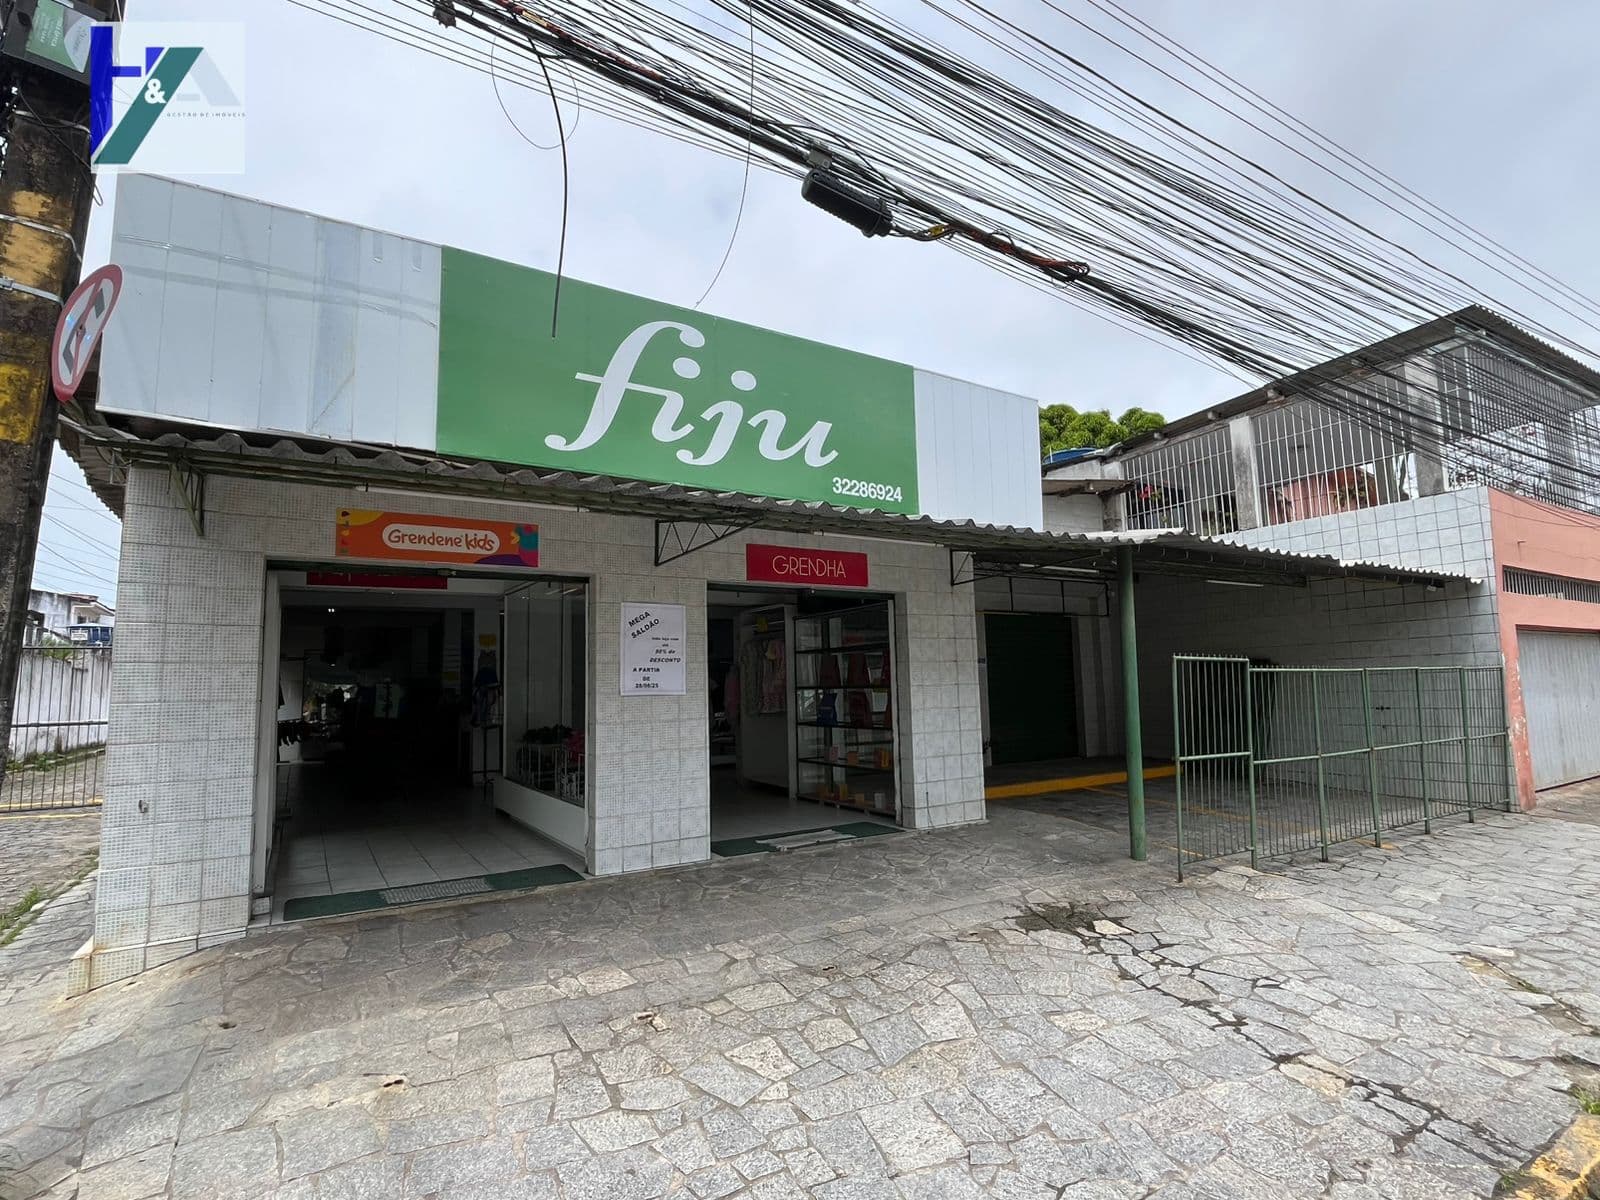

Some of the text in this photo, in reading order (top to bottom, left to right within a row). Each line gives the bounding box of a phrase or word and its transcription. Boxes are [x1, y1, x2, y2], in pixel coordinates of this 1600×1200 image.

[544, 321, 839, 467] fiju
[832, 476, 903, 503] 32286924
[388, 529, 495, 551] Grendene kids
[772, 555, 846, 578] GRENDHA
[628, 611, 651, 627] MEGA
